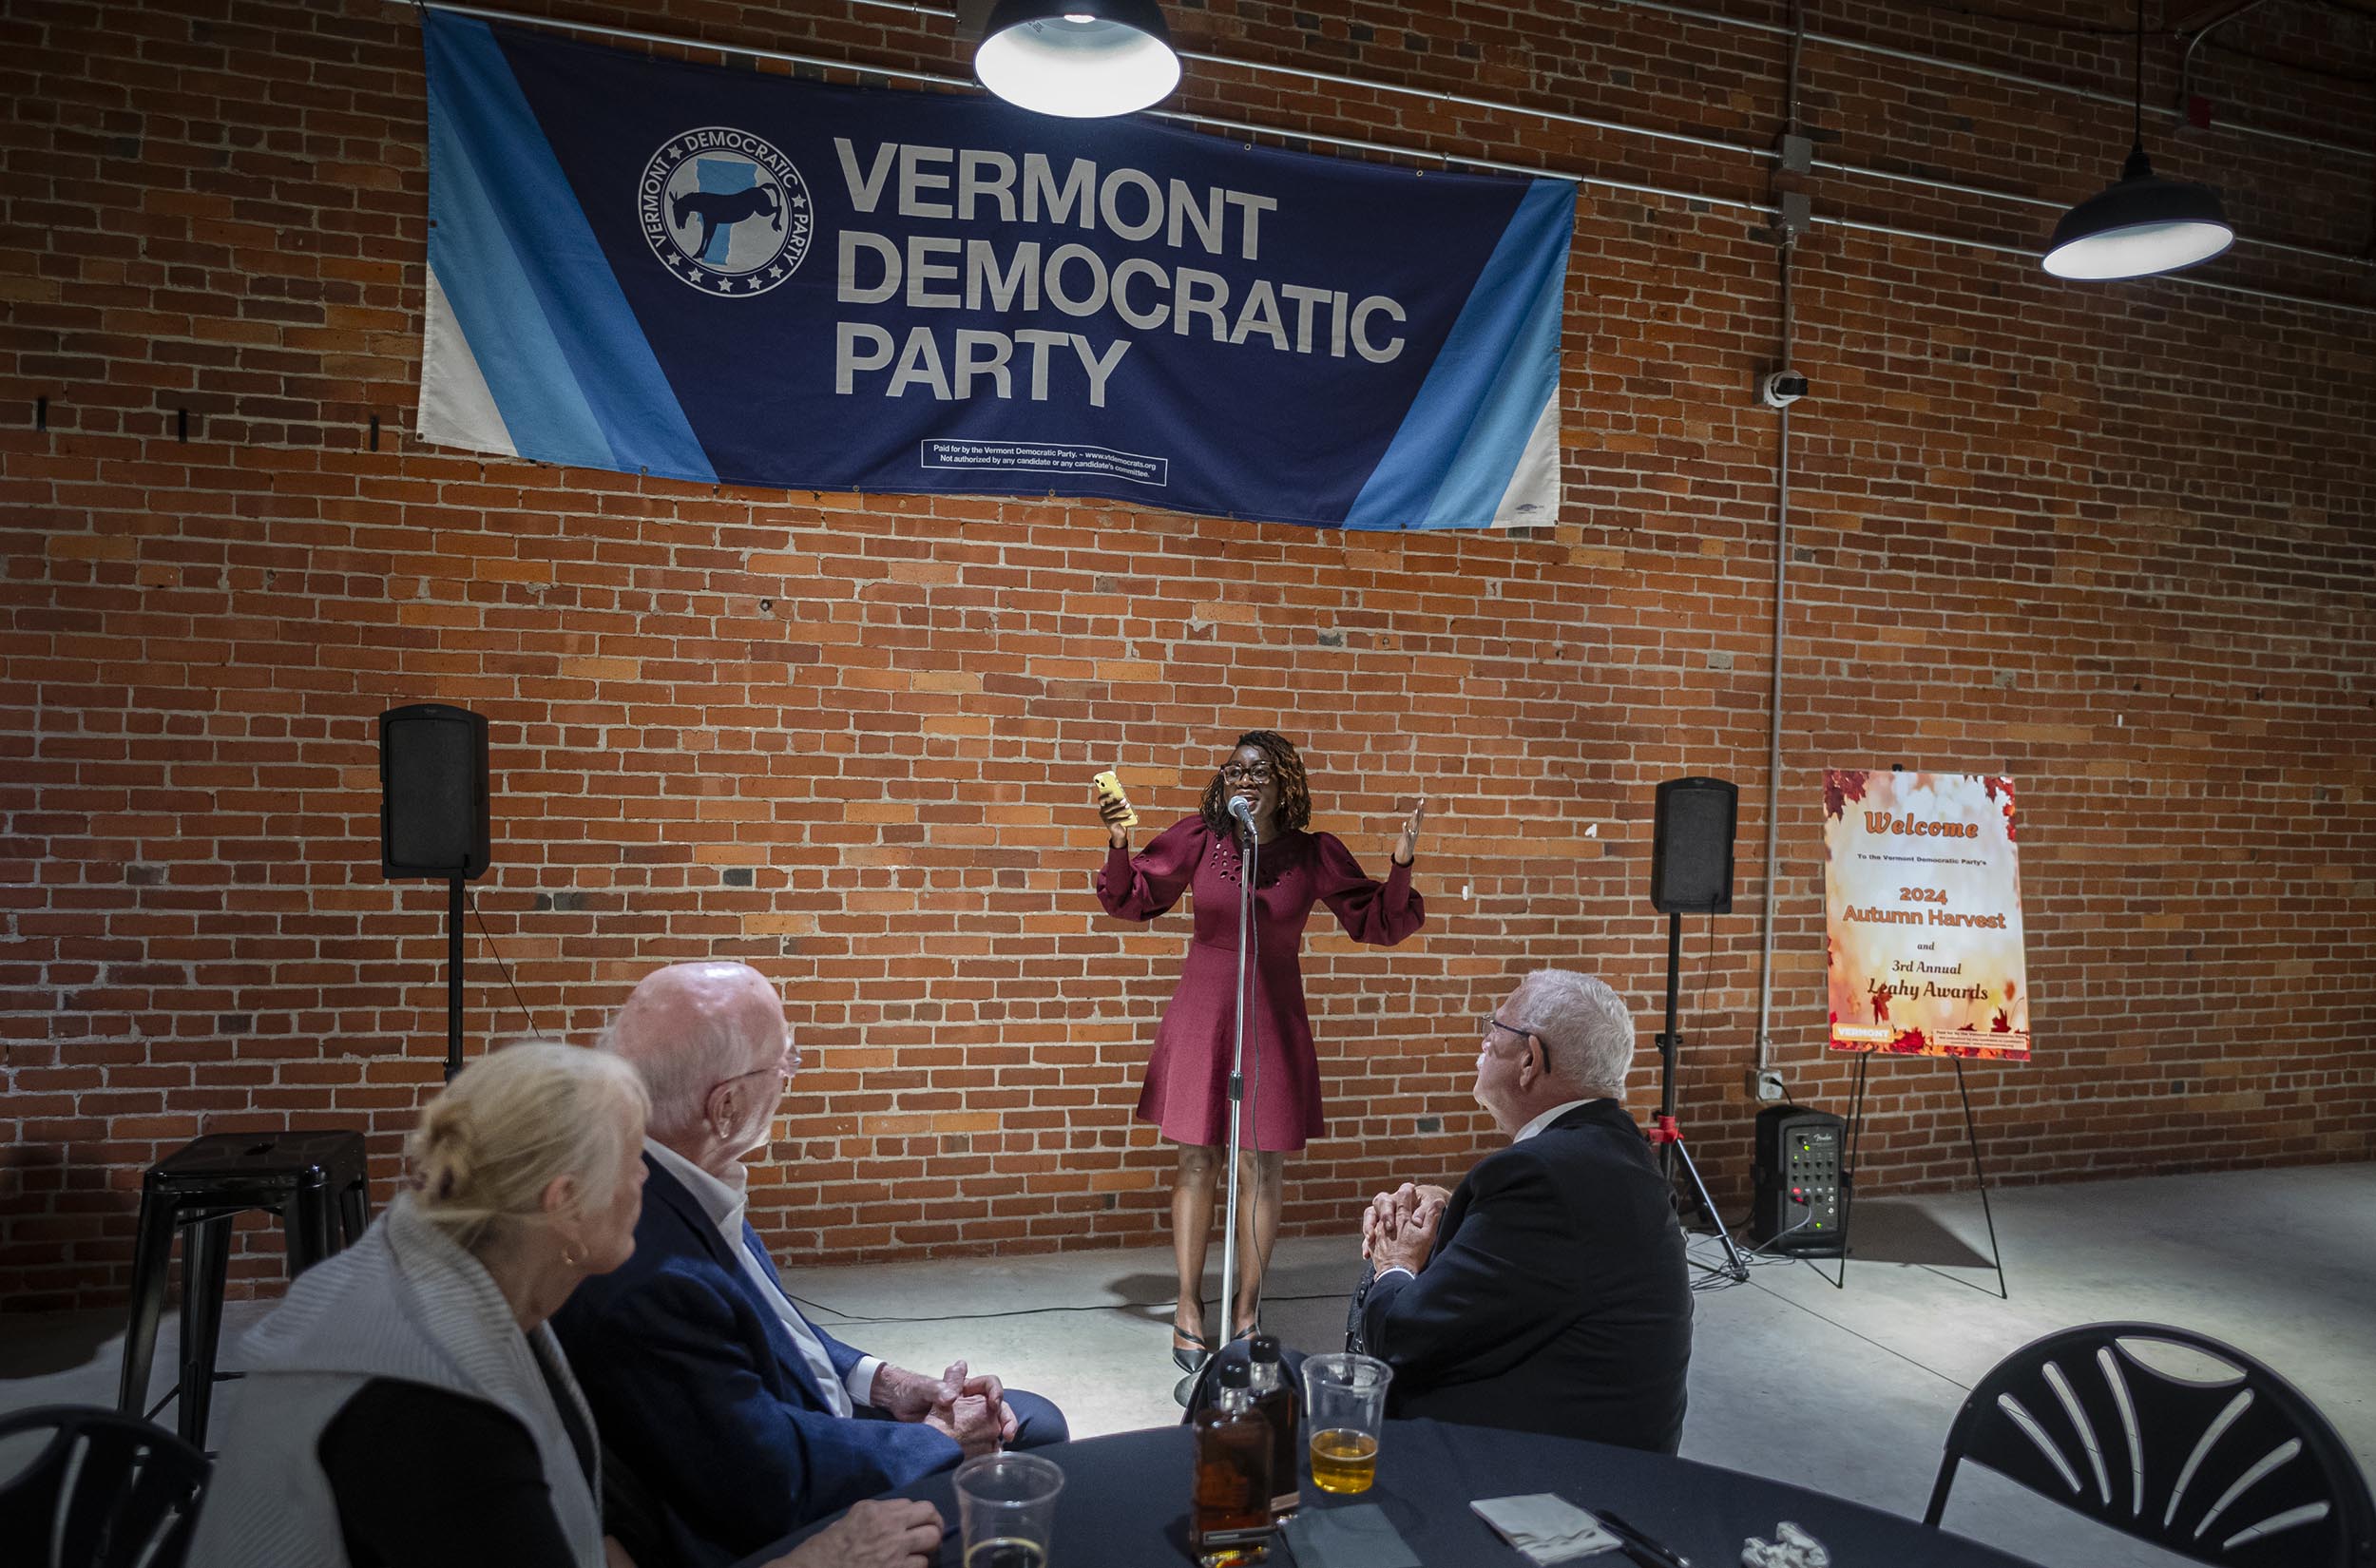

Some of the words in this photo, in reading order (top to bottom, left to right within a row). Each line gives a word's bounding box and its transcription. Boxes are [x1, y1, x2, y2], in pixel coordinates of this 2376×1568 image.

[684, 131, 798, 188] DEMOCRATIC
[642, 157, 671, 247] VERMONT
[834, 137, 1276, 260] VERMONT
[782, 214, 809, 266] PARTY
[836, 230, 1407, 363] DEMOCRATIC
[834, 321, 1132, 407] PARTY
[933, 444, 949, 452] Paid
[962, 446, 969, 454] by
[1016, 448, 1057, 456] Democratic
[1057, 449, 1078, 458] Party.
[1085, 451, 1156, 470] www.vtdemocrats.org
[992, 456, 1001, 465] by
[1016, 457, 1051, 466] candidate
[1074, 460, 1114, 470] candidate's
[1115, 466, 1150, 478] committee.
[1864, 811, 1979, 838] Welcome
[1899, 887, 1948, 905] 2024
[1843, 905, 1924, 926] Autumn
[1928, 909, 2006, 929] Harvest
[1917, 942, 1935, 951] and
[1891, 960, 1913, 973] 3rd
[1917, 962, 1962, 975] Annual
[1867, 977, 1919, 1000] Leahy
[1923, 981, 1988, 1001] Awards
